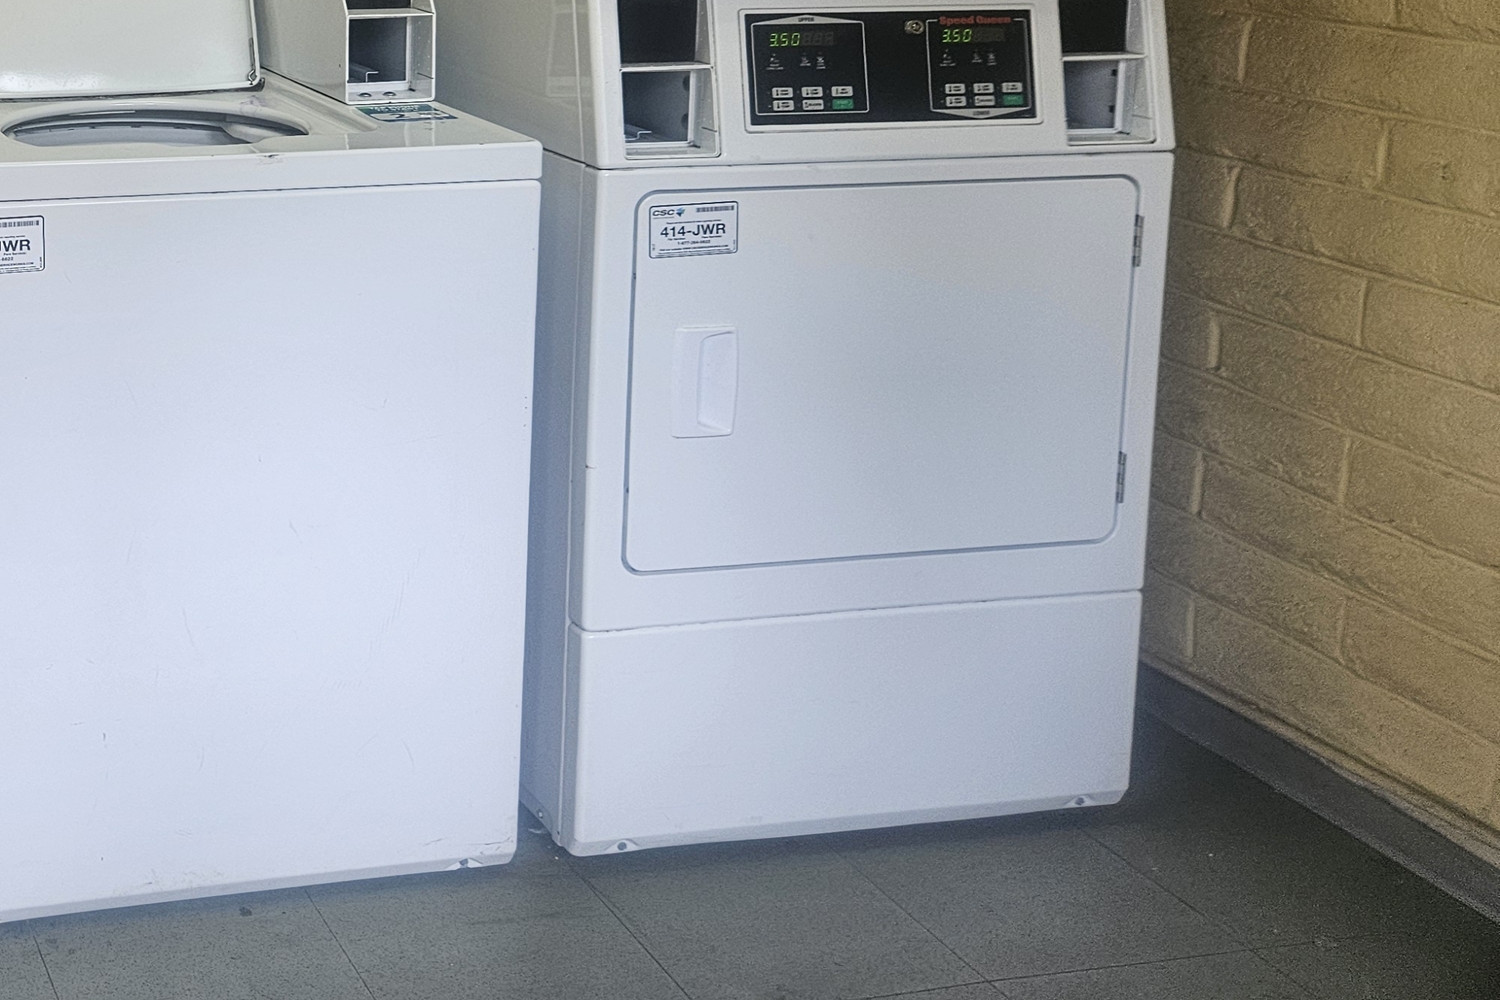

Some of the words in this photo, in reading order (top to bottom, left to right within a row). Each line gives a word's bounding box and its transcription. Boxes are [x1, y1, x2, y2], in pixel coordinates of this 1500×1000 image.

[939, 16, 975, 26] Speed
[976, 16, 1012, 24] Queen
[769, 32, 801, 47] 3.50
[941, 28, 973, 43] 3.50
[652, 209, 675, 217] CSC
[660, 223, 726, 238] 414-JWR
